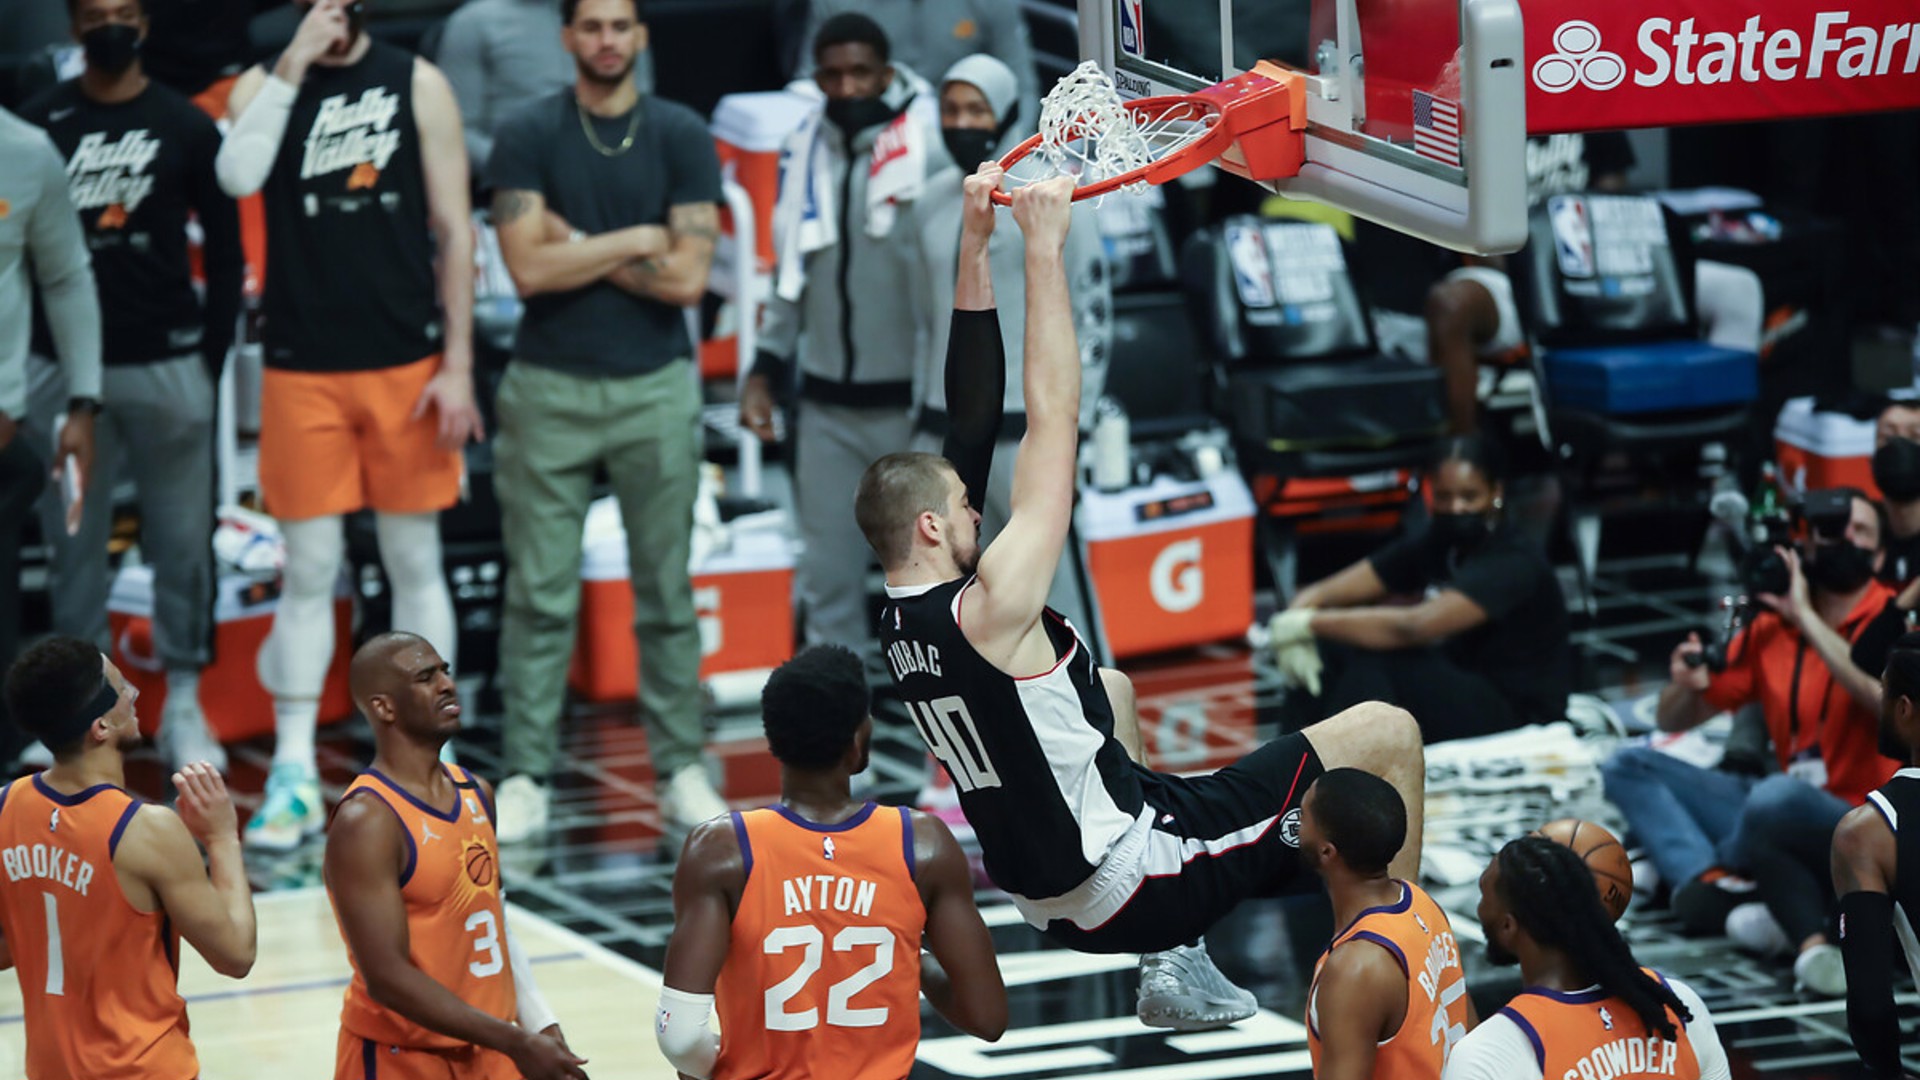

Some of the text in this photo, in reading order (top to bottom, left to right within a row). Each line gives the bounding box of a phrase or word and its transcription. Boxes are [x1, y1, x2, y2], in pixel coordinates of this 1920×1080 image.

[305, 86, 399, 142] Rally
[66, 128, 161, 177] Rally
[1150, 537, 1204, 613] G
[887, 640, 942, 682] ZUBAC
[904, 696, 1002, 792] 40
[3, 844, 94, 896] BOOKER
[783, 875, 876, 916] AYTON
[42, 892, 64, 995] 1
[465, 909, 503, 978] 3
[764, 925, 896, 1031] 22
